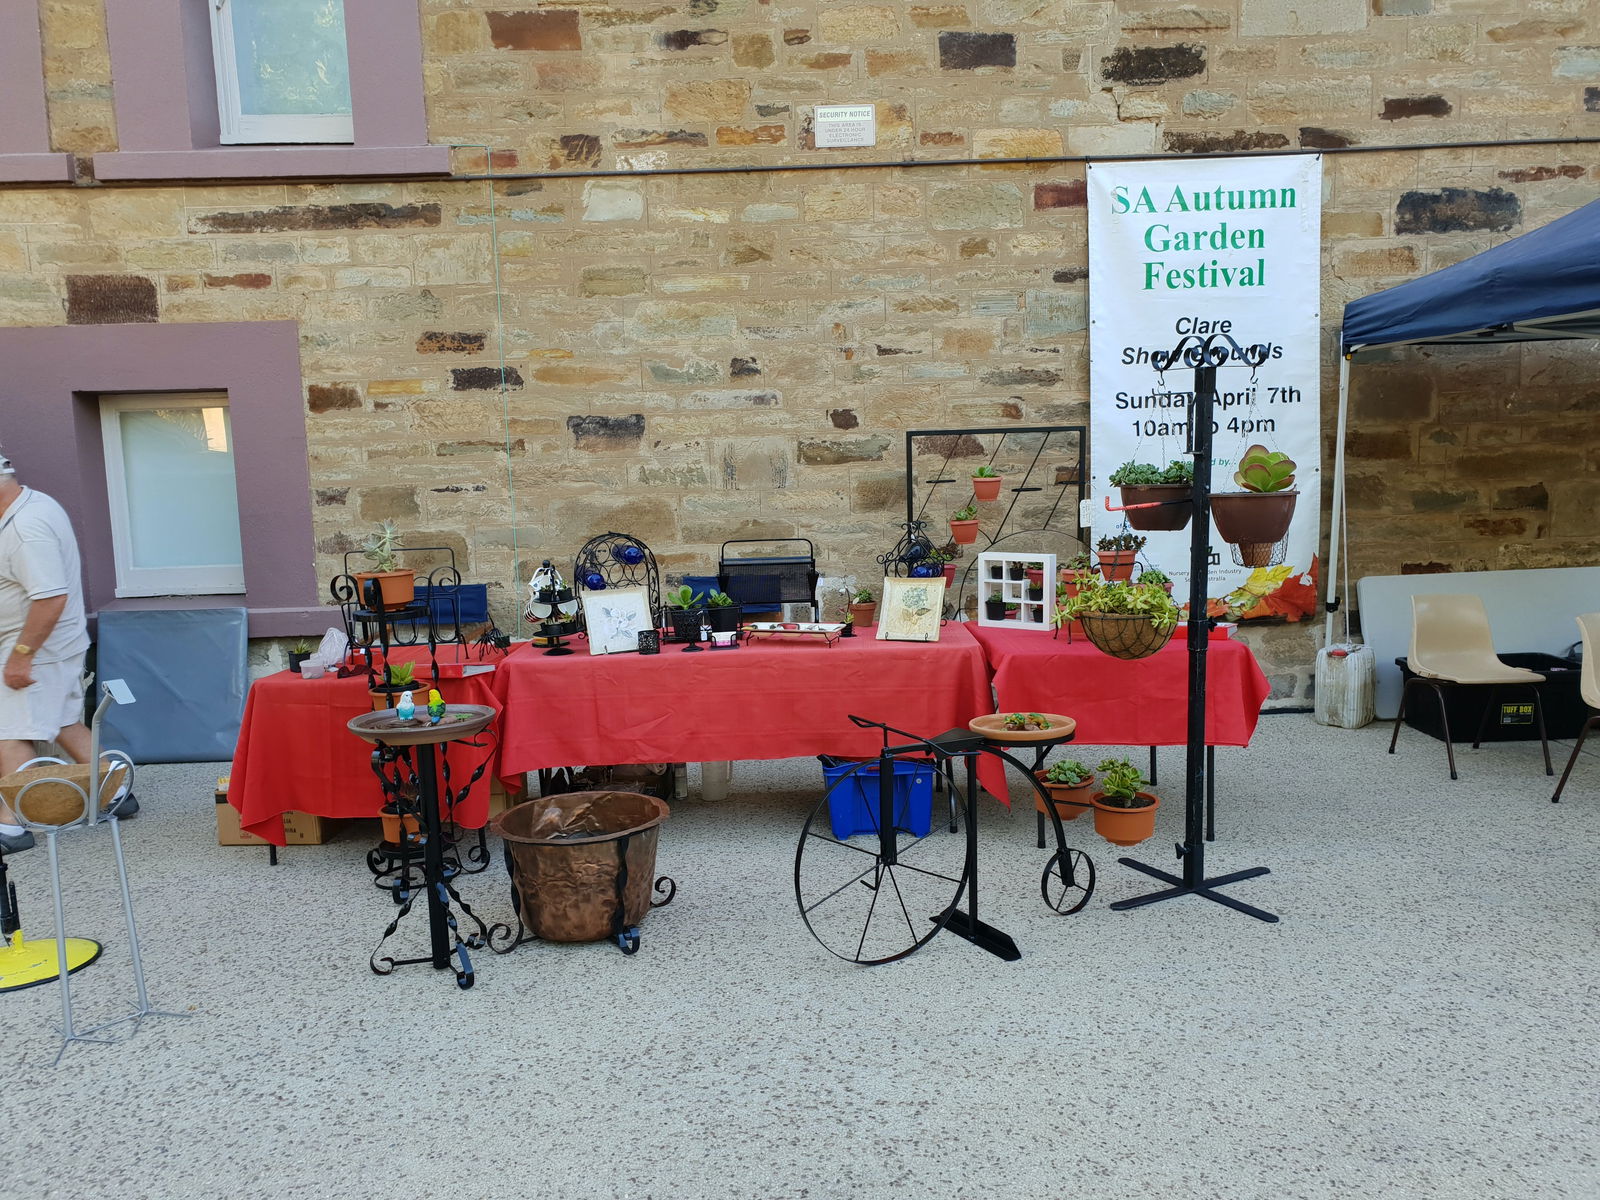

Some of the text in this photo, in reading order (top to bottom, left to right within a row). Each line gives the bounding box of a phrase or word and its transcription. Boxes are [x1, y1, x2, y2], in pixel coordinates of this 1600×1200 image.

[819, 111, 848, 119] SECURITY
[1111, 184, 1297, 214] SA Autumn
[1143, 222, 1266, 252] Garden
[1142, 258, 1266, 291] Festival
[1175, 317, 1232, 335] Clare
[1115, 385, 1302, 411] Sunday April 7th
[1132, 420, 1189, 437] 10am
[1226, 416, 1276, 437] 4pm
[1218, 567, 1242, 575] Industry
[1503, 705, 1532, 713] TUFF BOX
